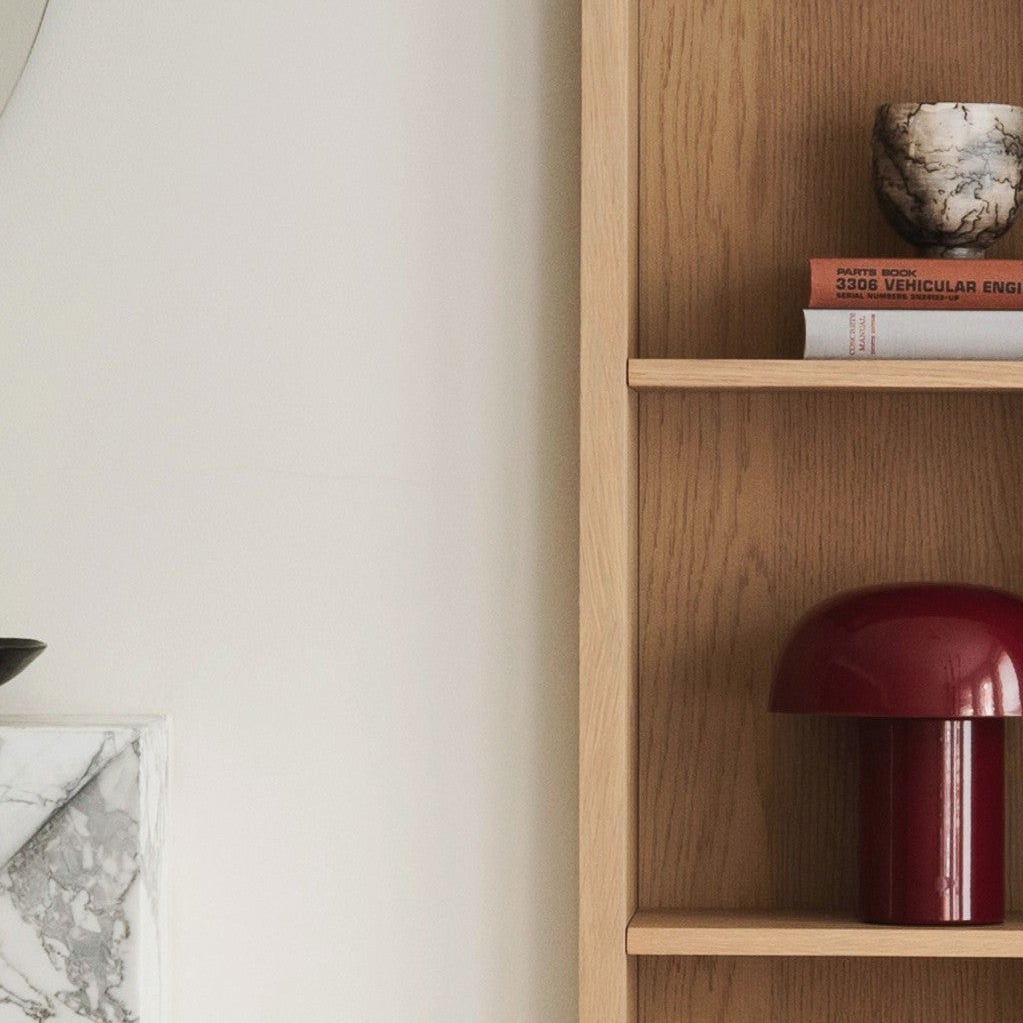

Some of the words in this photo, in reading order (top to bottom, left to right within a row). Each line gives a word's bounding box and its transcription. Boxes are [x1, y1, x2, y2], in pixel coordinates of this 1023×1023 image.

[836, 268, 877, 277] PARTS
[881, 268, 917, 278] BOOK
[836, 278, 878, 291] 3306
[884, 278, 977, 293] VEHICULAR
[867, 292, 908, 300] NUMBERS
